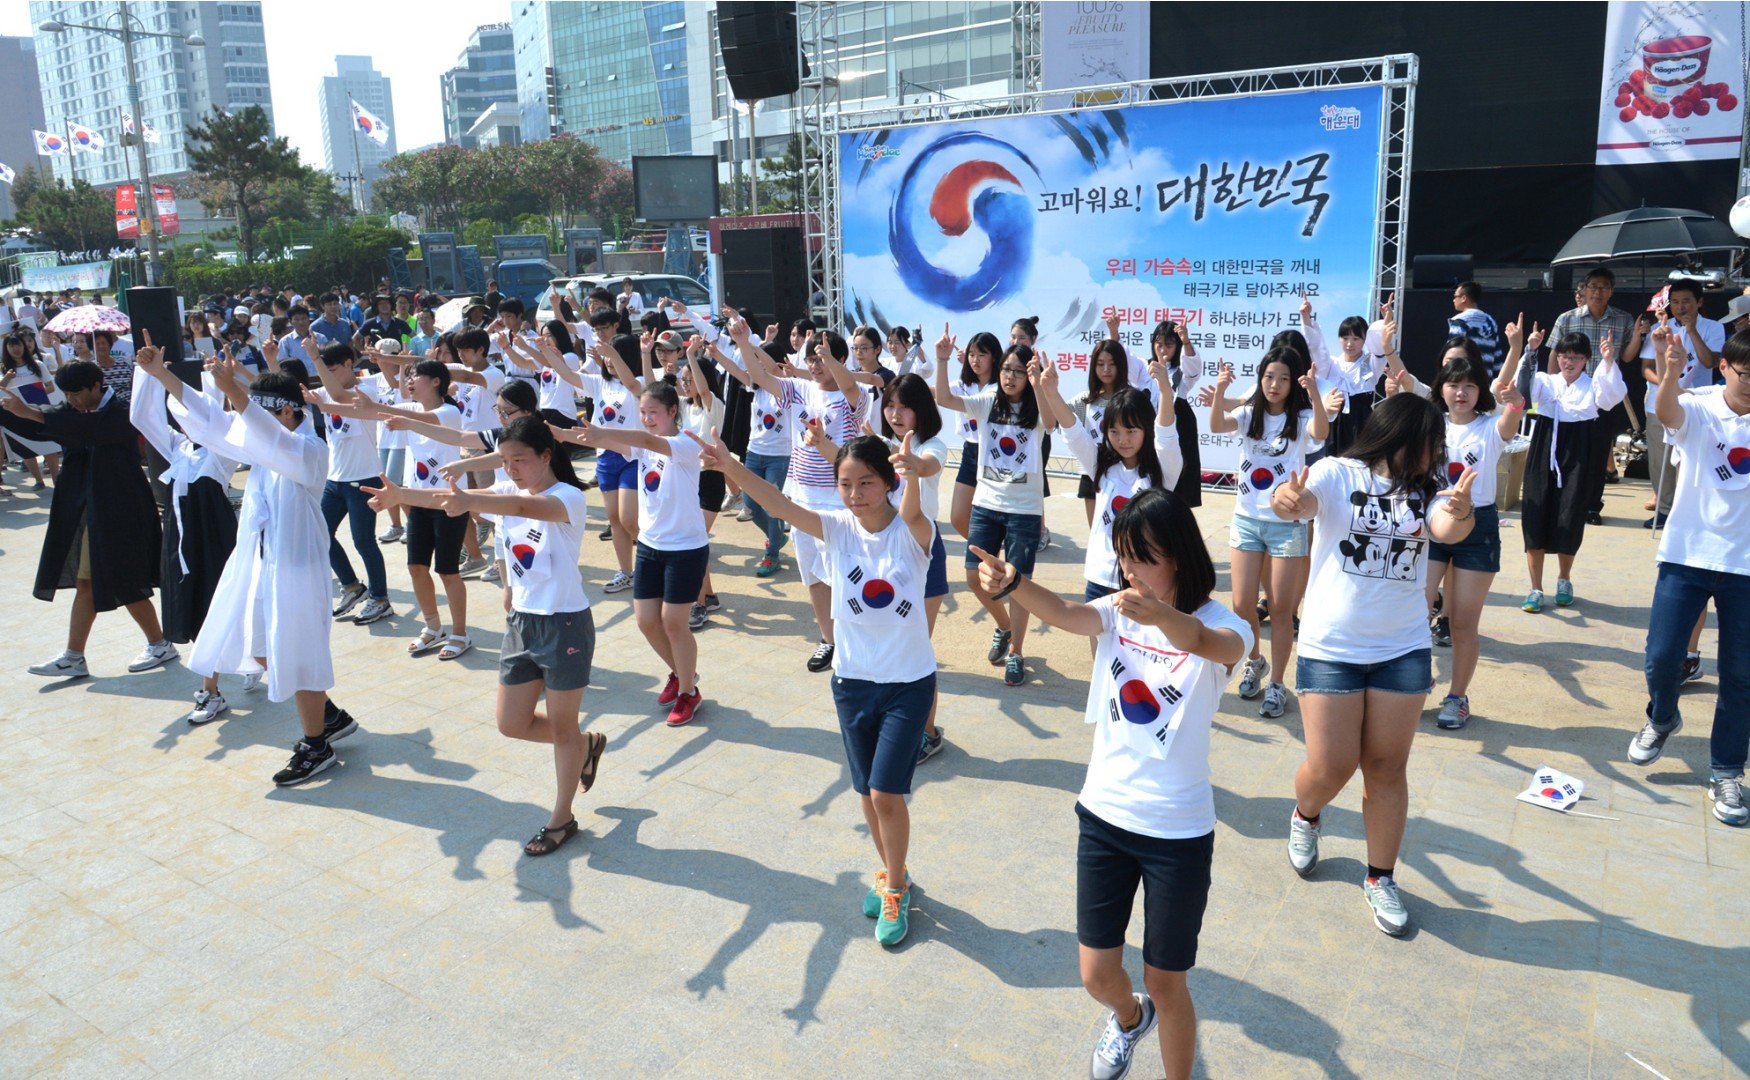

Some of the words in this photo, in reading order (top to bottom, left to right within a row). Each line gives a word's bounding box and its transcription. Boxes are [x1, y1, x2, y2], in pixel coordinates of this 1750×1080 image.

[498, 21, 512, 30] SK
[1068, 22, 1127, 35] PLEASURE
[1321, 114, 1360, 129] 해운대
[1037, 184, 1142, 214] 고마워요!
[1156, 153, 1330, 236] 대한민국
[1106, 258, 1137, 276] 우리
[1143, 258, 1206, 276] 가슴속의
[1212, 259, 1284, 275] 대한민국을
[1290, 258, 1321, 275] 꺼내
[1184, 282, 1239, 297] 태극기로
[1246, 282, 1320, 297] 달아주세요
[1210, 312, 1282, 327] 하나하나가
[1080, 331, 1144, 346] 자랑러운
[1223, 334, 1265, 349] 만들어
[1199, 433, 1234, 447] 운대구
